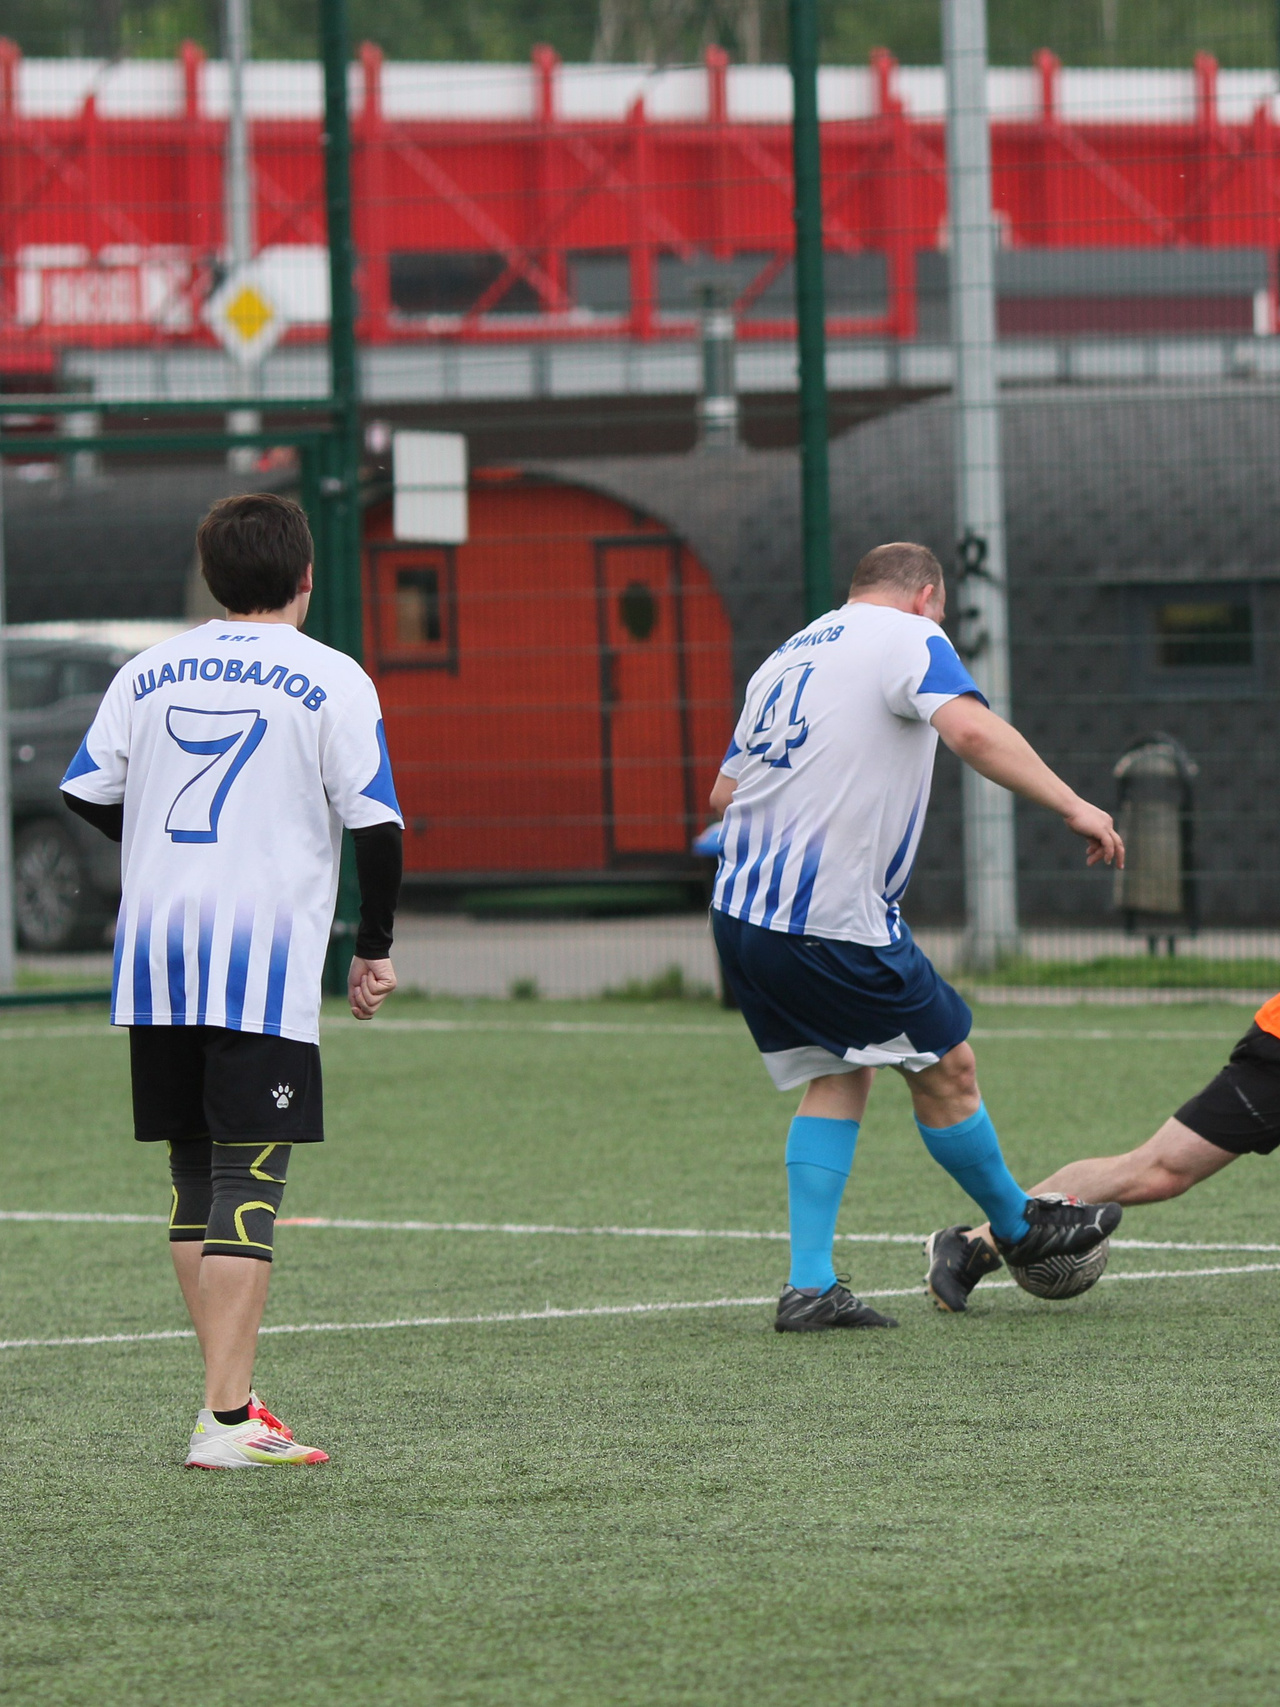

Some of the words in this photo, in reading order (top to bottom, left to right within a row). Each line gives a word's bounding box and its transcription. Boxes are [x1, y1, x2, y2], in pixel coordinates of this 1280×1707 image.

[133, 658, 327, 711] ШАПОВАЛОВ
[746, 661, 815, 769] 4
[165, 705, 268, 843] 7
